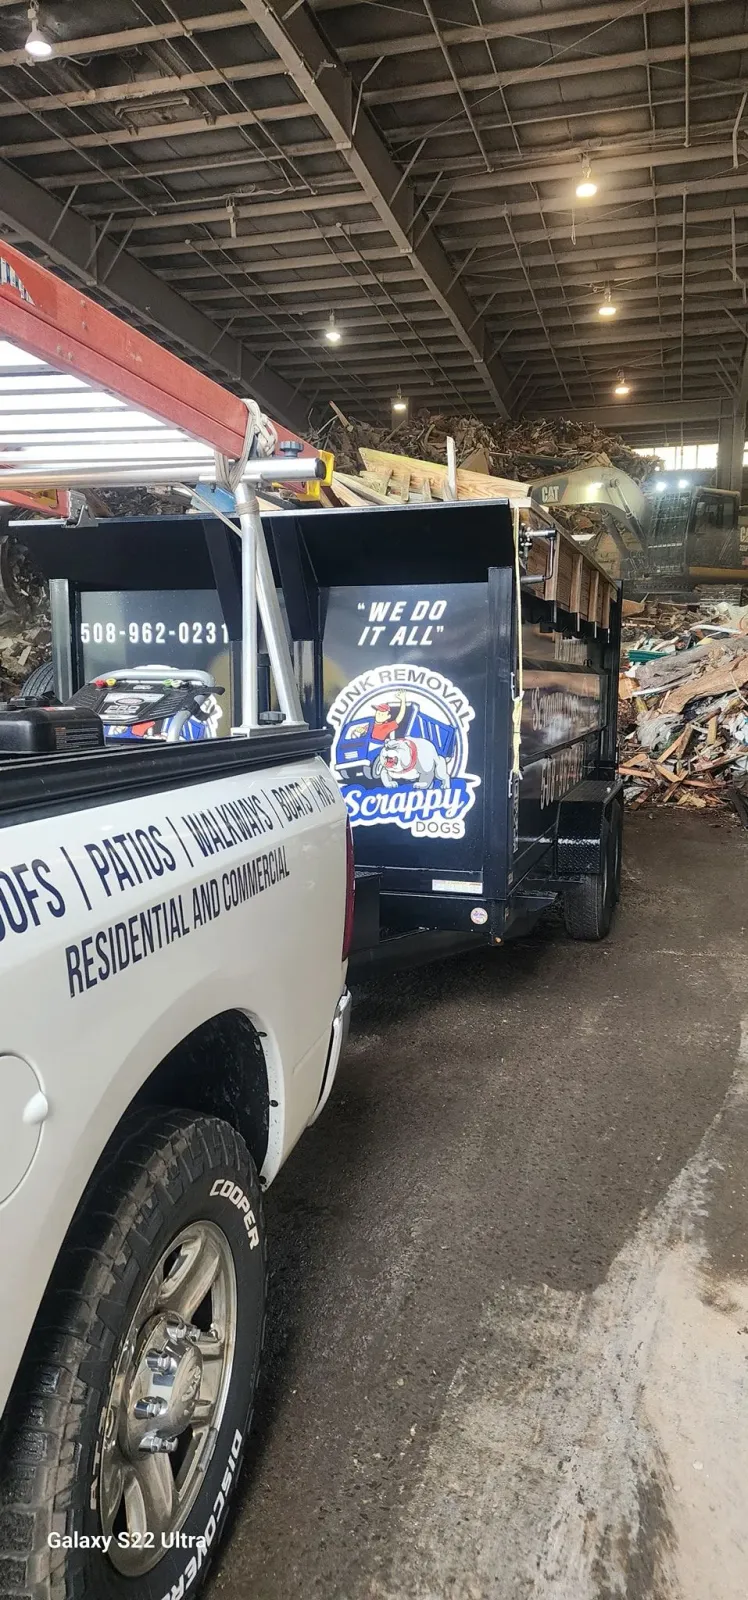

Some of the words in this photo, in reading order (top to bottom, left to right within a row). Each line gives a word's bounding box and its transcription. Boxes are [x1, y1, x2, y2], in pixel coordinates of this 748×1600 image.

[541, 486, 560, 503] CAT
[410, 600, 447, 621] DO
[80, 622, 229, 644] 508-962-0231
[358, 626, 386, 646] IT
[330, 676, 375, 727] JUNK
[379, 668, 473, 728] REMOVAL
[344, 788, 463, 818] Scrappy
[416, 821, 461, 835] DOGS
[0, 859, 66, 942] OFS
[84, 825, 176, 897] PATIOS
[181, 794, 274, 857] WALKWAYS
[271, 782, 314, 822] BOATS
[65, 895, 190, 998] RESIDENTIAL
[192, 878, 221, 929] AND
[222, 845, 290, 911] COMMERCIAL
[209, 1179, 260, 1251] COOPER
